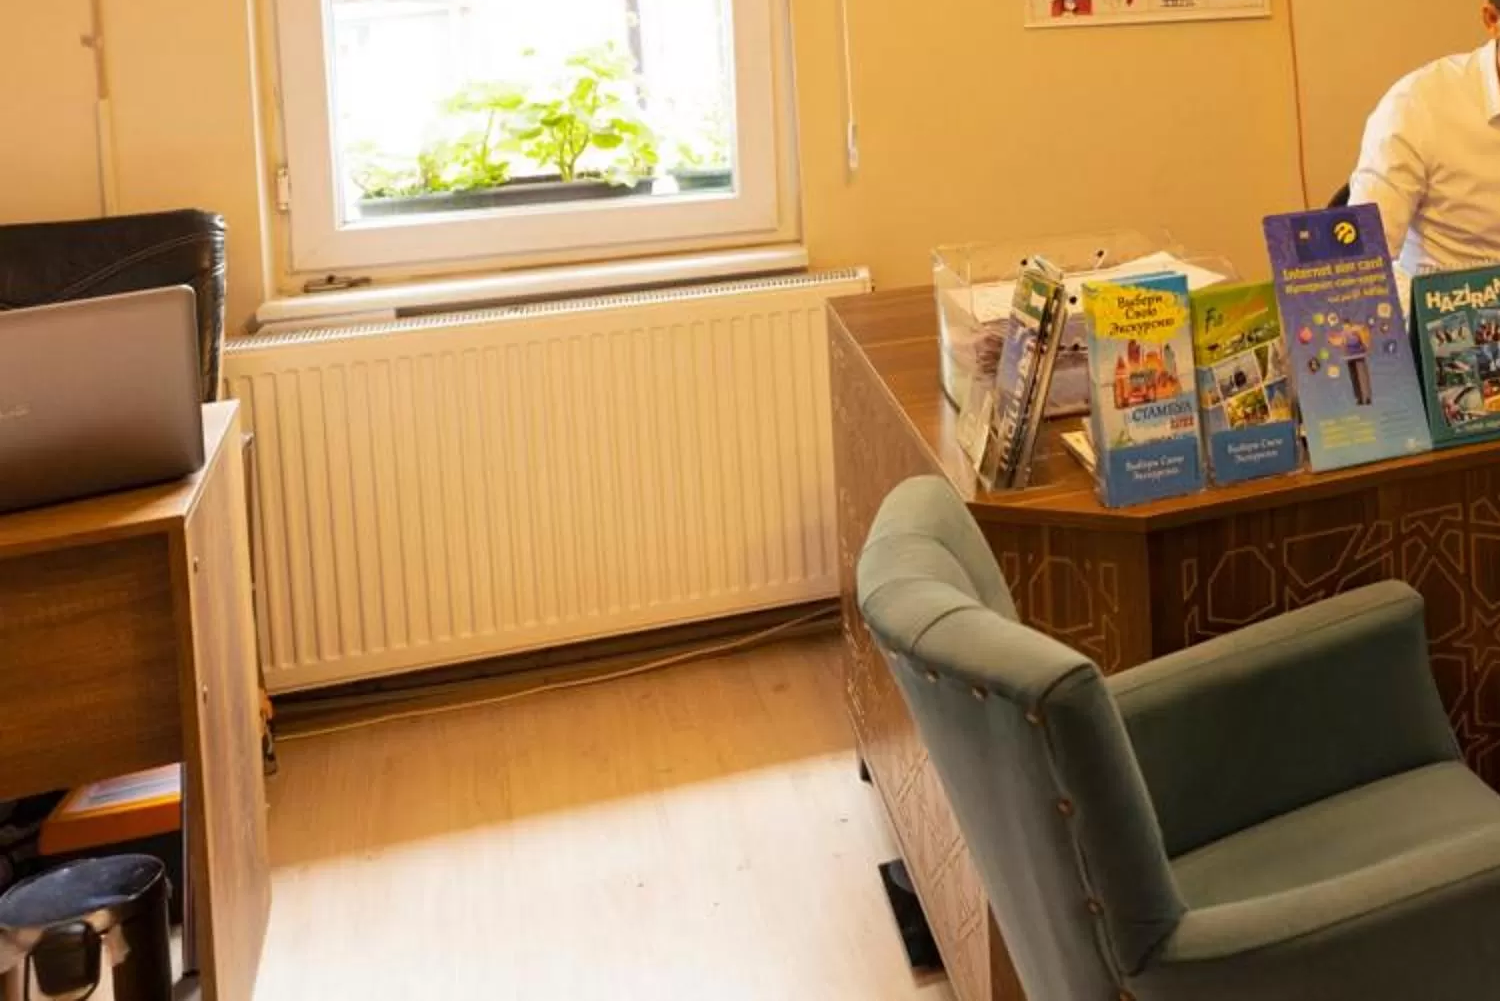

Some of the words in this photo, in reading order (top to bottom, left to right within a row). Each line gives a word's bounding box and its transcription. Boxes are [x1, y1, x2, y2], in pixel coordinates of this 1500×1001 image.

[1283, 264, 1332, 280] Internet
[1358, 256, 1383, 269] card
[1117, 293, 1162, 309] Выбери
